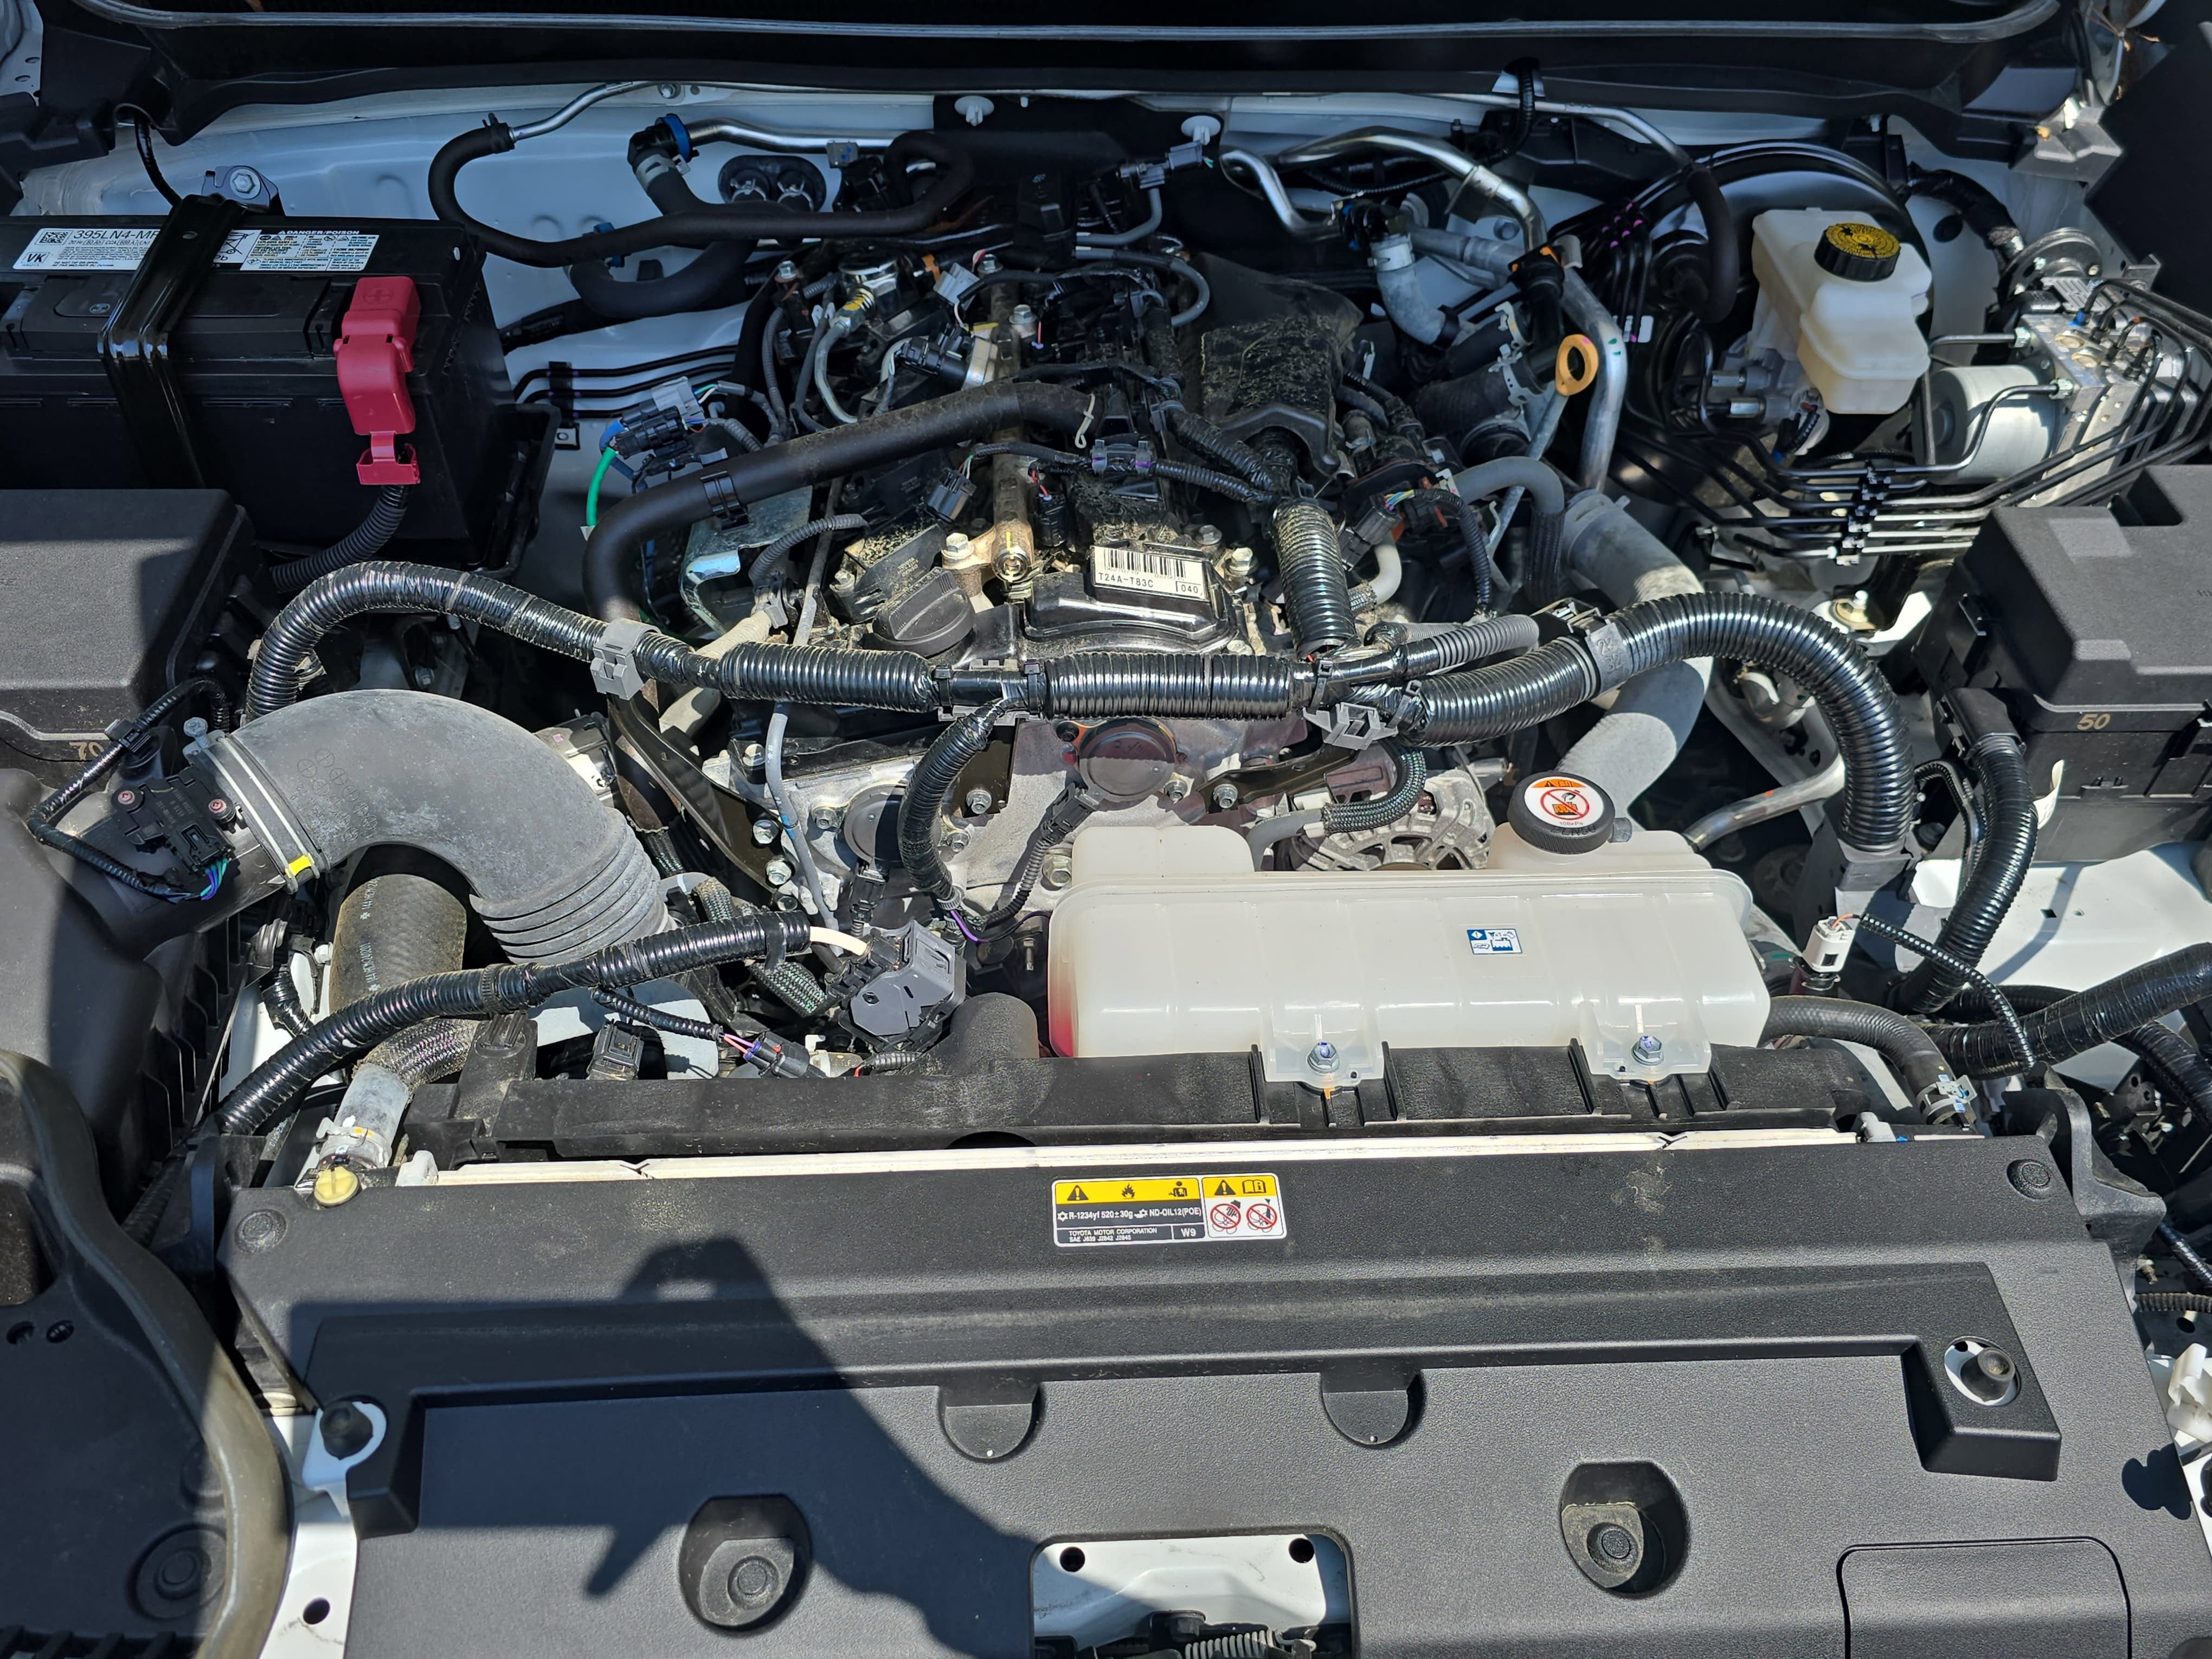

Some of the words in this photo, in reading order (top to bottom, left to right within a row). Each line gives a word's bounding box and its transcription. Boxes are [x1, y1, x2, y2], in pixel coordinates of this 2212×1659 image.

[27, 253, 46, 263] VK
[1098, 572, 1154, 588] T24A-T83C
[1181, 583, 1199, 594] 040
[2076, 713, 2111, 731] 50
[1149, 1207, 1201, 1218] ND-OIL12(POE)
[1181, 1227, 1197, 1237] W9
